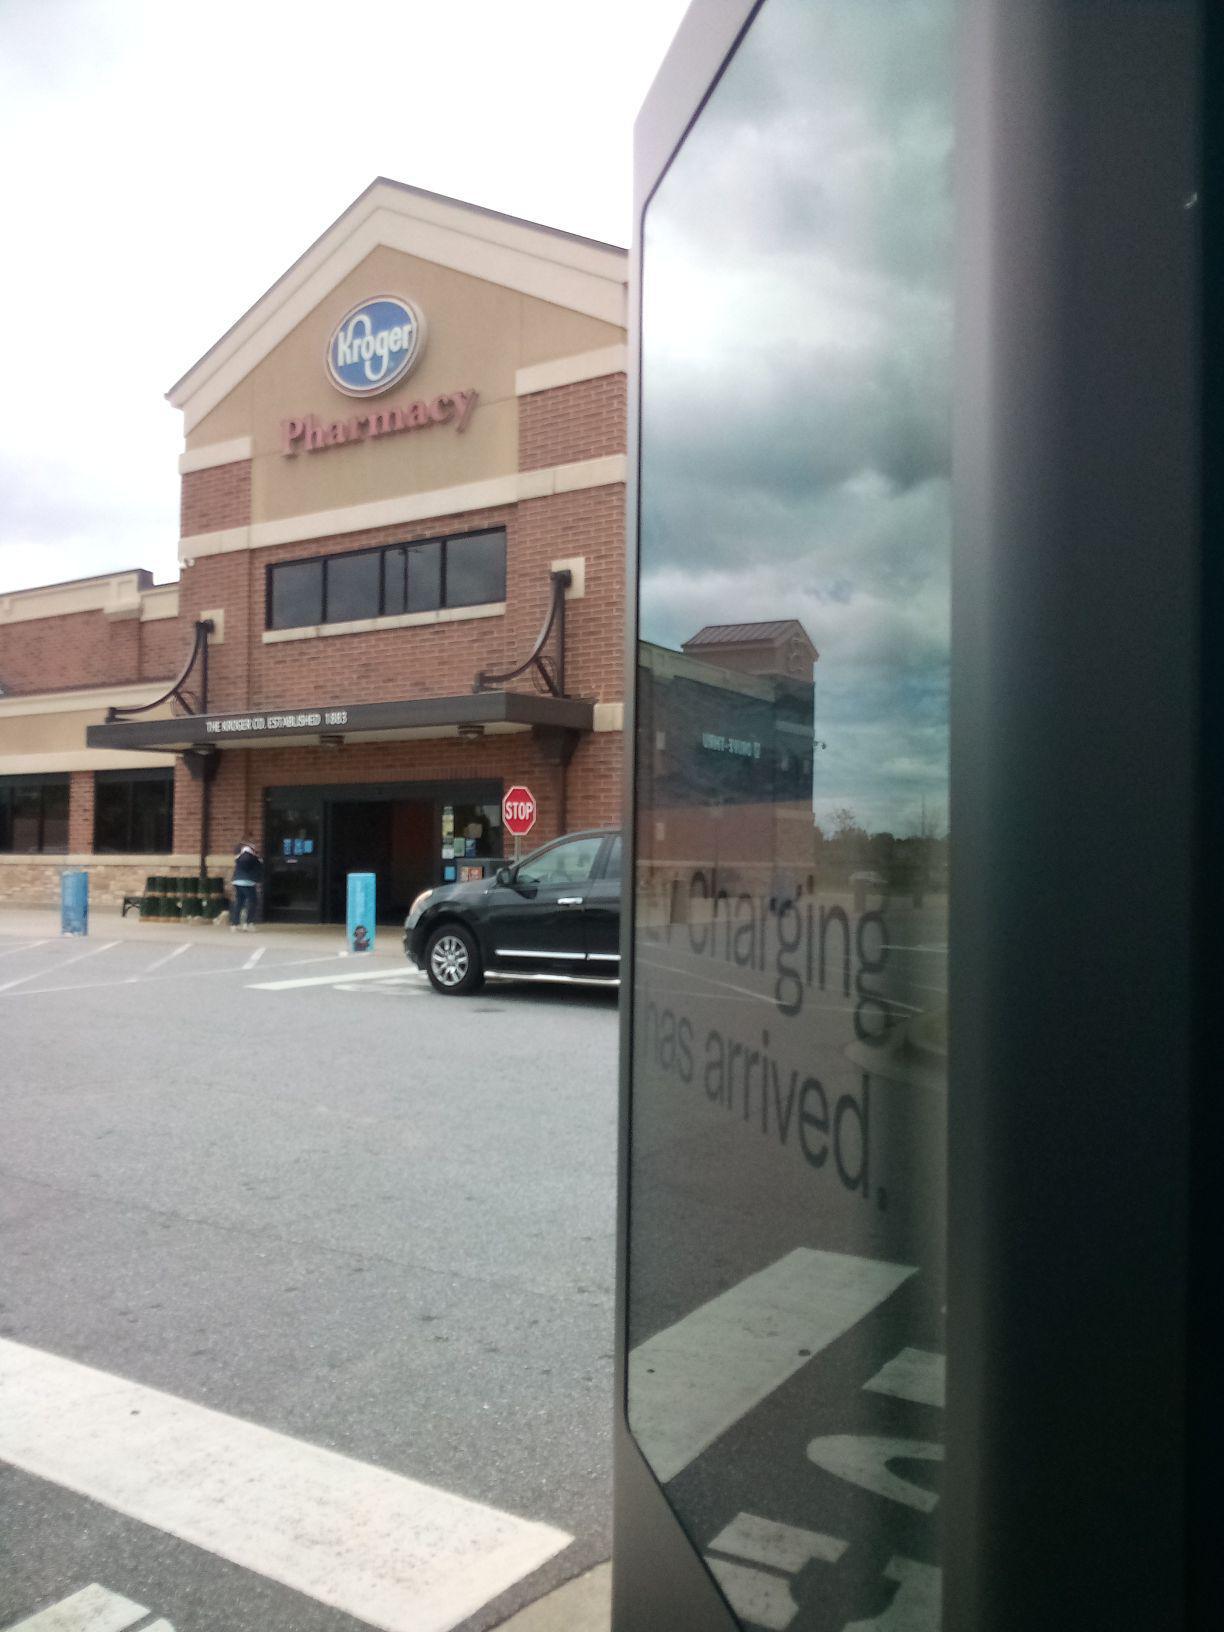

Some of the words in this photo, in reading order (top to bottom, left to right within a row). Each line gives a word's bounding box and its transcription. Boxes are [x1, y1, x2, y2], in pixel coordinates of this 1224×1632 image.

[337, 314, 413, 381] Kroger
[282, 388, 480, 458] Pharmacy
[206, 720, 221, 733] THE
[267, 713, 321, 729] ESTABLISHED
[505, 801, 534, 820] STOP
